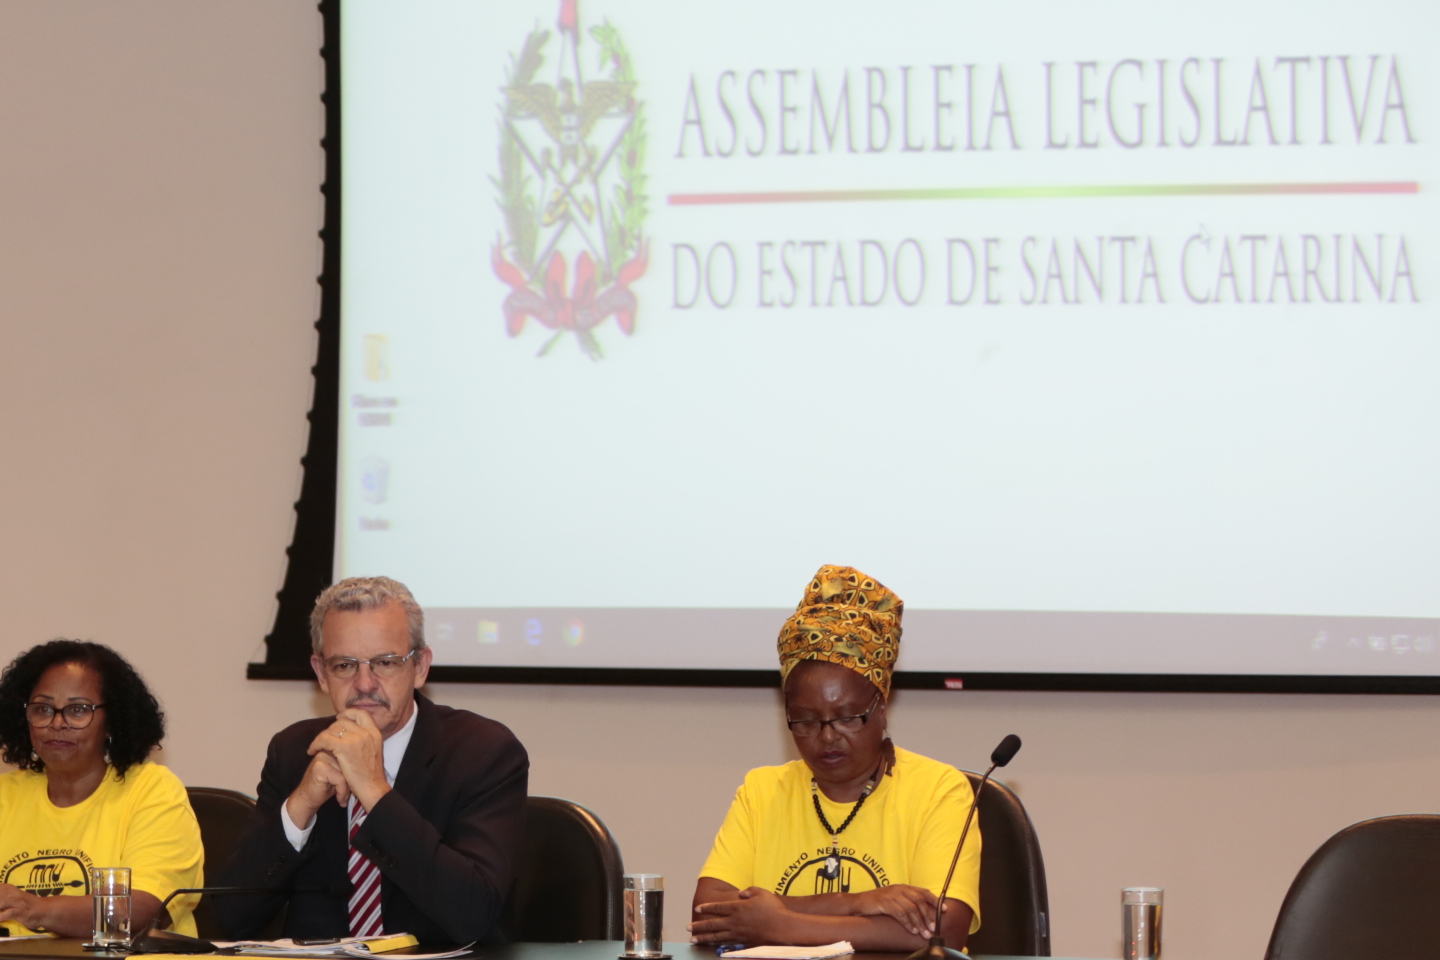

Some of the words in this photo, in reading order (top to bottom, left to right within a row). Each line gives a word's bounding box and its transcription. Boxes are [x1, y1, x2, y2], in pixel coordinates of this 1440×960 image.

[673, 62, 1023, 159] ASSEMBLEIA
[1042, 53, 1418, 150] LEGISLATIVA
[670, 241, 738, 309] DO
[756, 237, 926, 308] ESTADO
[945, 236, 1002, 306] DE
[1019, 234, 1167, 306] SANTA
[1180, 232, 1421, 305] CATARINA
[773, 852, 809, 895] IMENTO
[862, 853, 890, 887] UNIFIC
